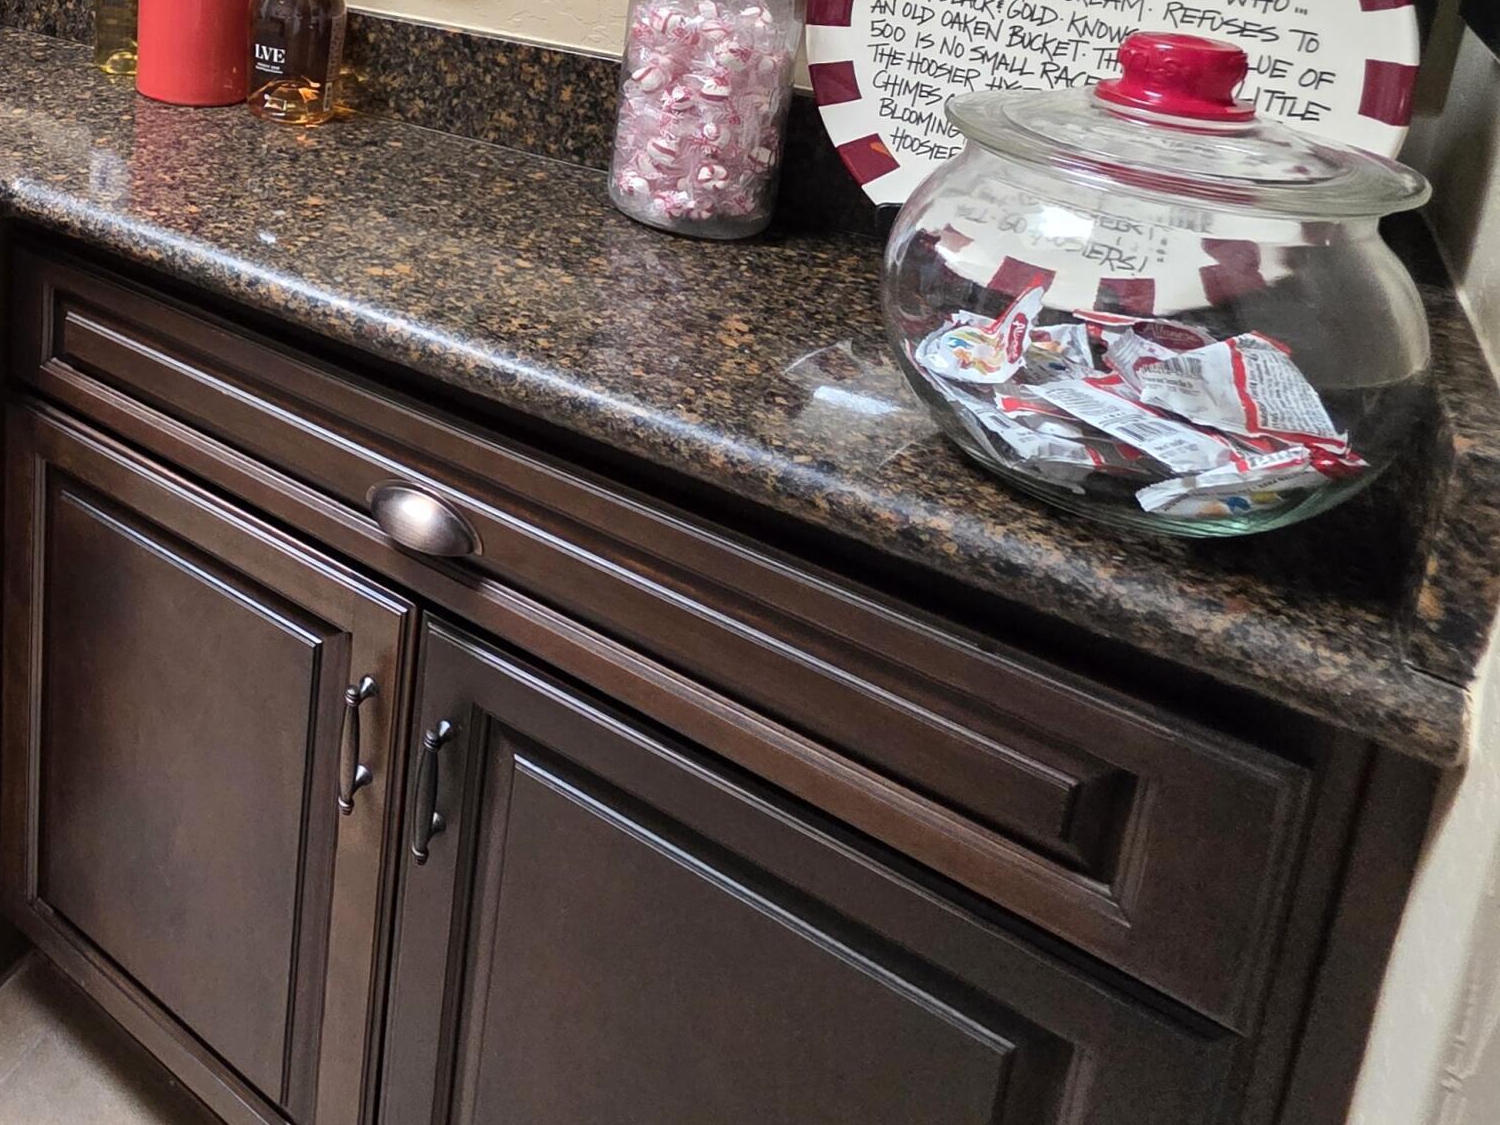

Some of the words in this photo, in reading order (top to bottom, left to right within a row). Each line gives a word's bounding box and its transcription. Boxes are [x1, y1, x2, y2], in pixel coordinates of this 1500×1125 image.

[901, 1, 936, 26] OLD
[940, 10, 1004, 42] OAKEN
[1163, 1, 1280, 42] REFUSES
[1288, 28, 1320, 54] TO
[867, 42, 906, 69] THE
[907, 51, 981, 92] HOOSIER
[870, 19, 906, 42] 500
[915, 31, 936, 49] IS
[939, 35, 965, 58] NO
[969, 45, 1035, 76] SMALL
[872, 69, 944, 107] CHIMES
[1297, 69, 1336, 91] OF
[879, 97, 962, 138] BLOOMING
